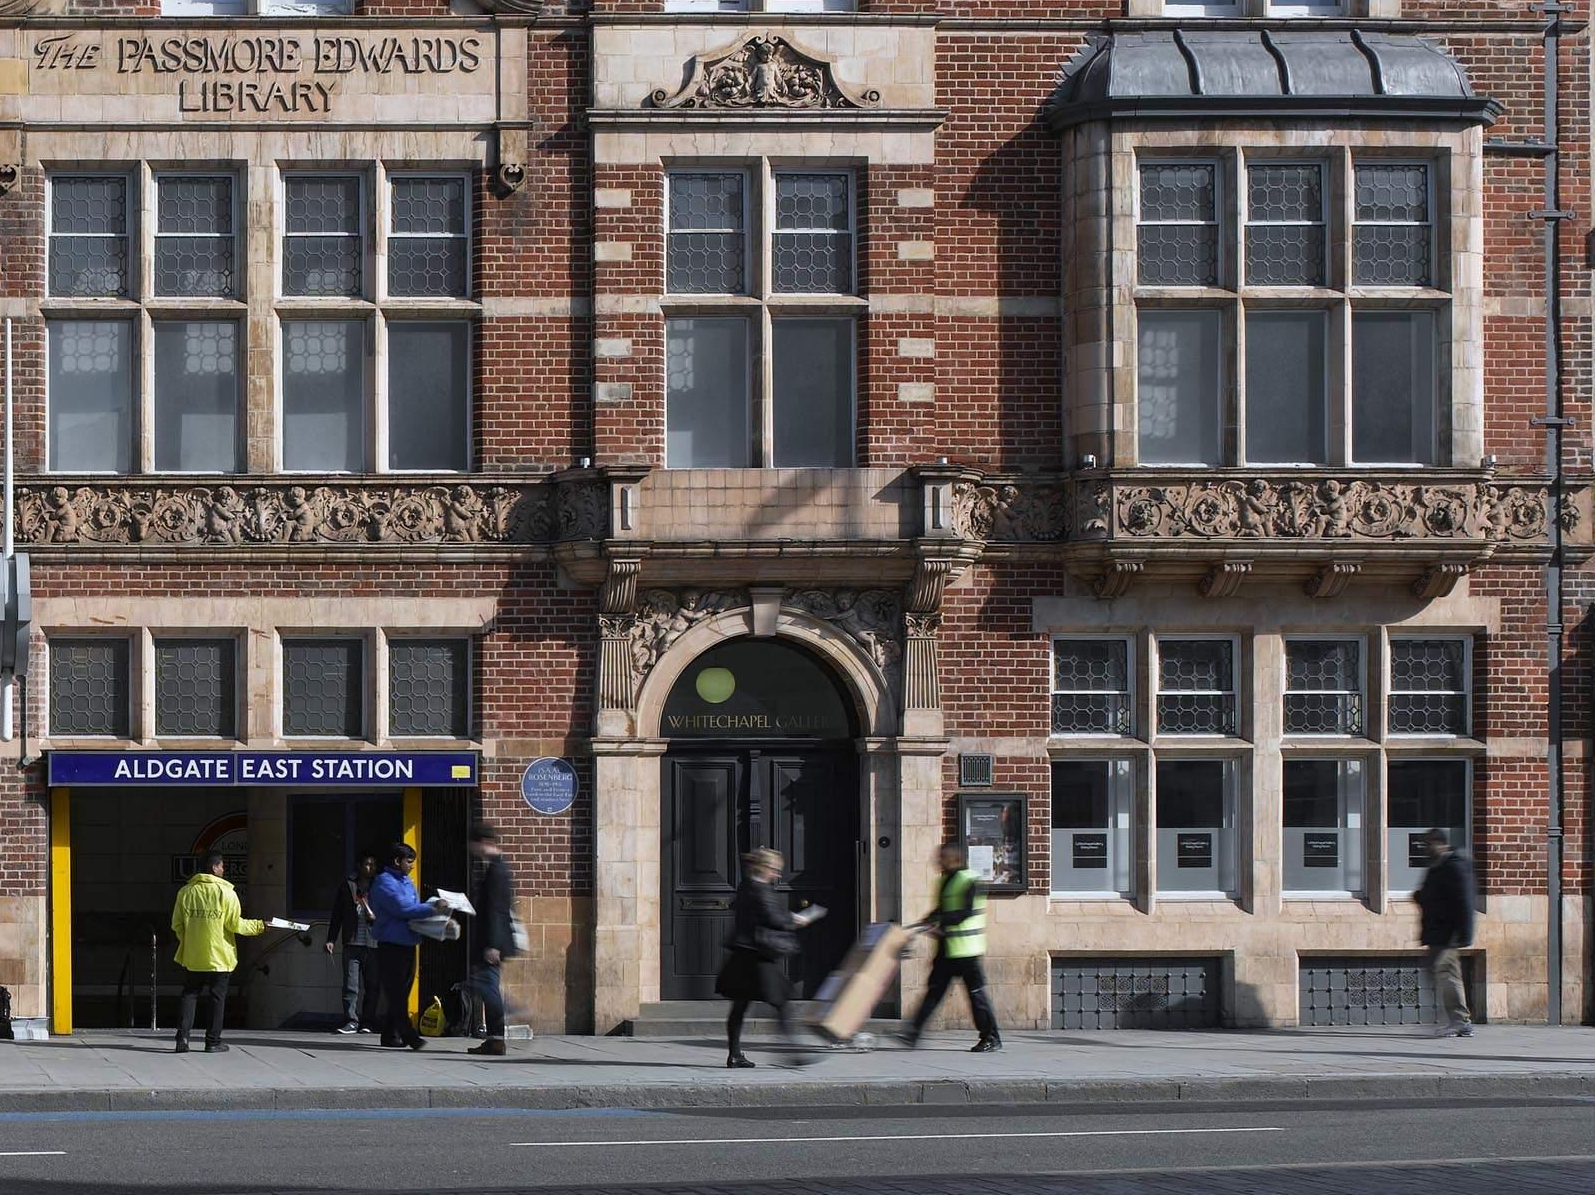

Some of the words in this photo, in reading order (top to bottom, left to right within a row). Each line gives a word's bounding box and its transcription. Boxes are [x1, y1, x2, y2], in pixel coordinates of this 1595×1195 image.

[117, 36, 303, 74] PASSMORE
[314, 36, 481, 74] EDWARDS
[179, 79, 336, 113] LIBRARY
[668, 714, 772, 729] WHITECHAPEL
[114, 759, 229, 779] ALDGATE
[242, 759, 303, 779] EAST
[311, 759, 414, 779] STATION
